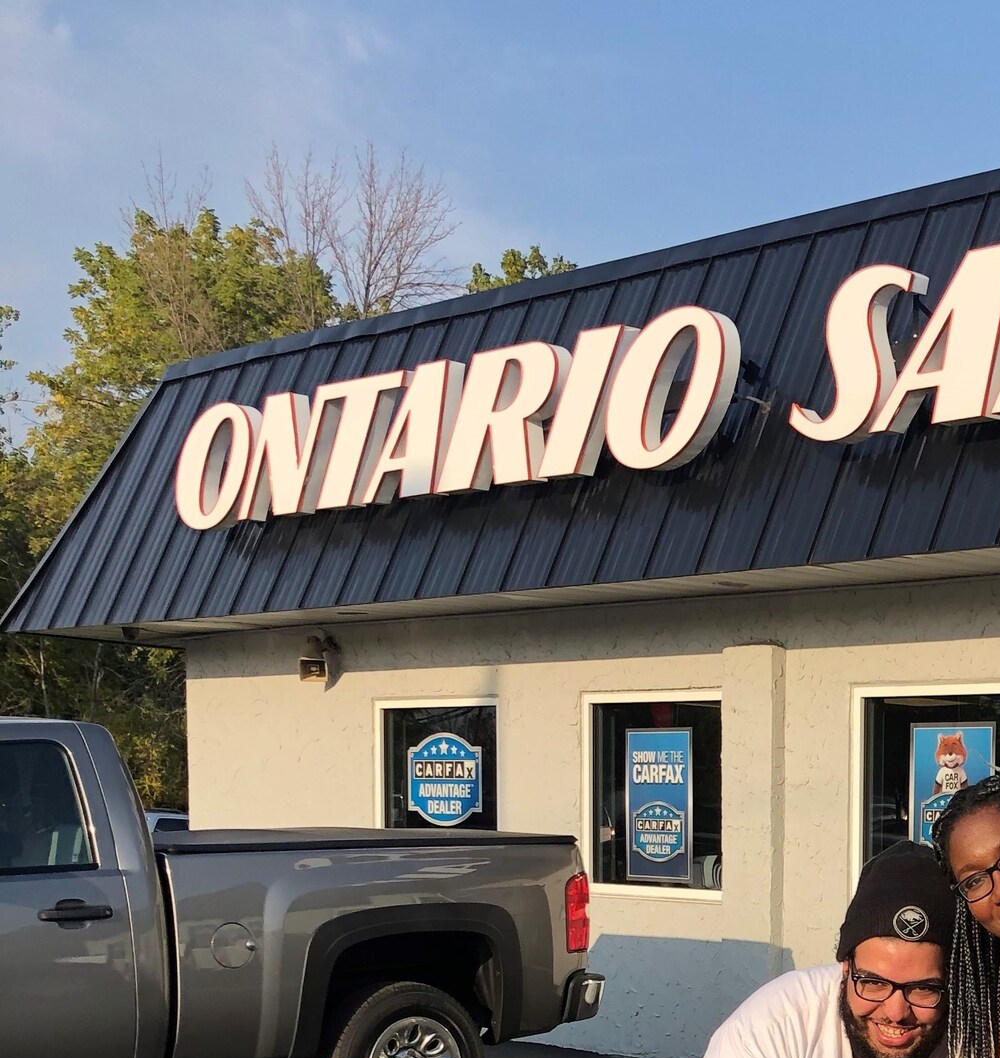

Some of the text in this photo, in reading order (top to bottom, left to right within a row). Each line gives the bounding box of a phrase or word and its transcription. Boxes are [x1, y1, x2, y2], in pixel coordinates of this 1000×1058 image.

[175, 305, 741, 530] ONTARIO
[632, 750, 684, 764] SHOW ME THE
[414, 762, 474, 779] CARFAX
[633, 764, 685, 784] CARFAX
[944, 773, 959, 781] CAR
[418, 783, 473, 799] ADVANTAGE
[945, 782, 959, 790] FOX
[427, 800, 463, 815] DEALER
[637, 820, 679, 832] CARFAX
[639, 833, 678, 844] ADVANTAGE
[645, 844, 671, 855] DEALER
